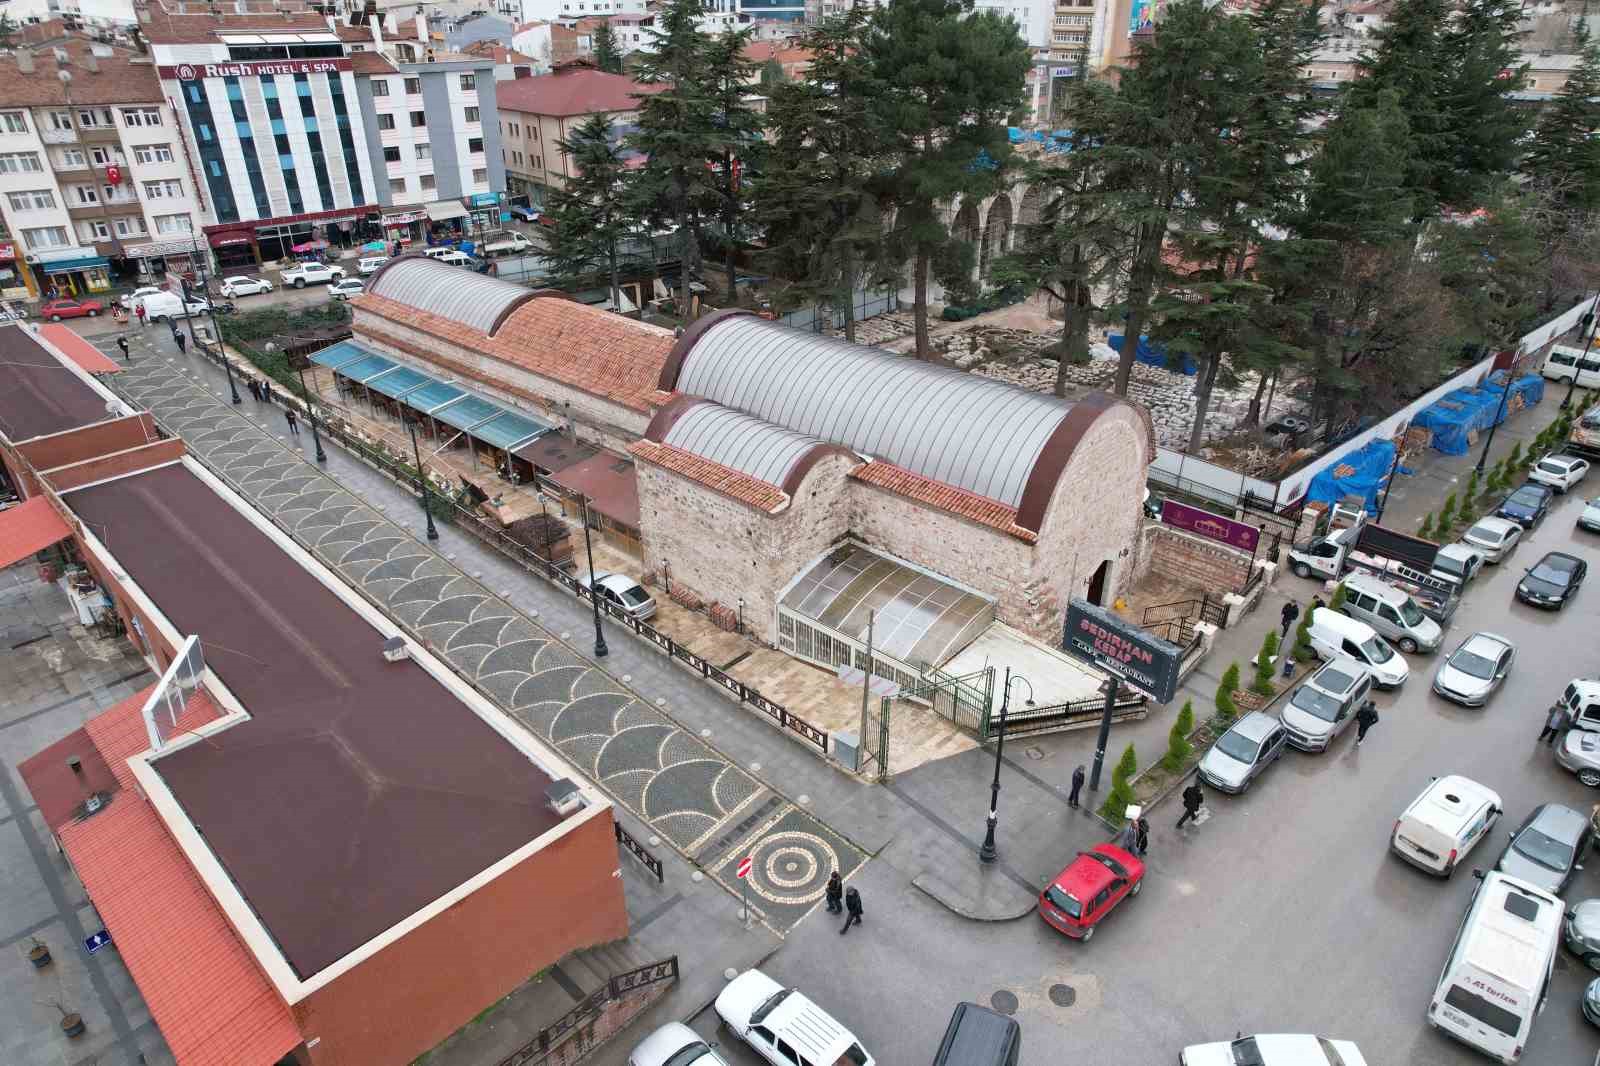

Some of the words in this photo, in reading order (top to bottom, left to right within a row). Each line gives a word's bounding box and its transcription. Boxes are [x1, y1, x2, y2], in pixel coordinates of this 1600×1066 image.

[205, 63, 252, 78] Rush
[258, 64, 298, 75] HOTEL
[301, 62, 309, 73] &
[313, 63, 337, 73] SPA
[1094, 638, 1132, 664] KEBAP
